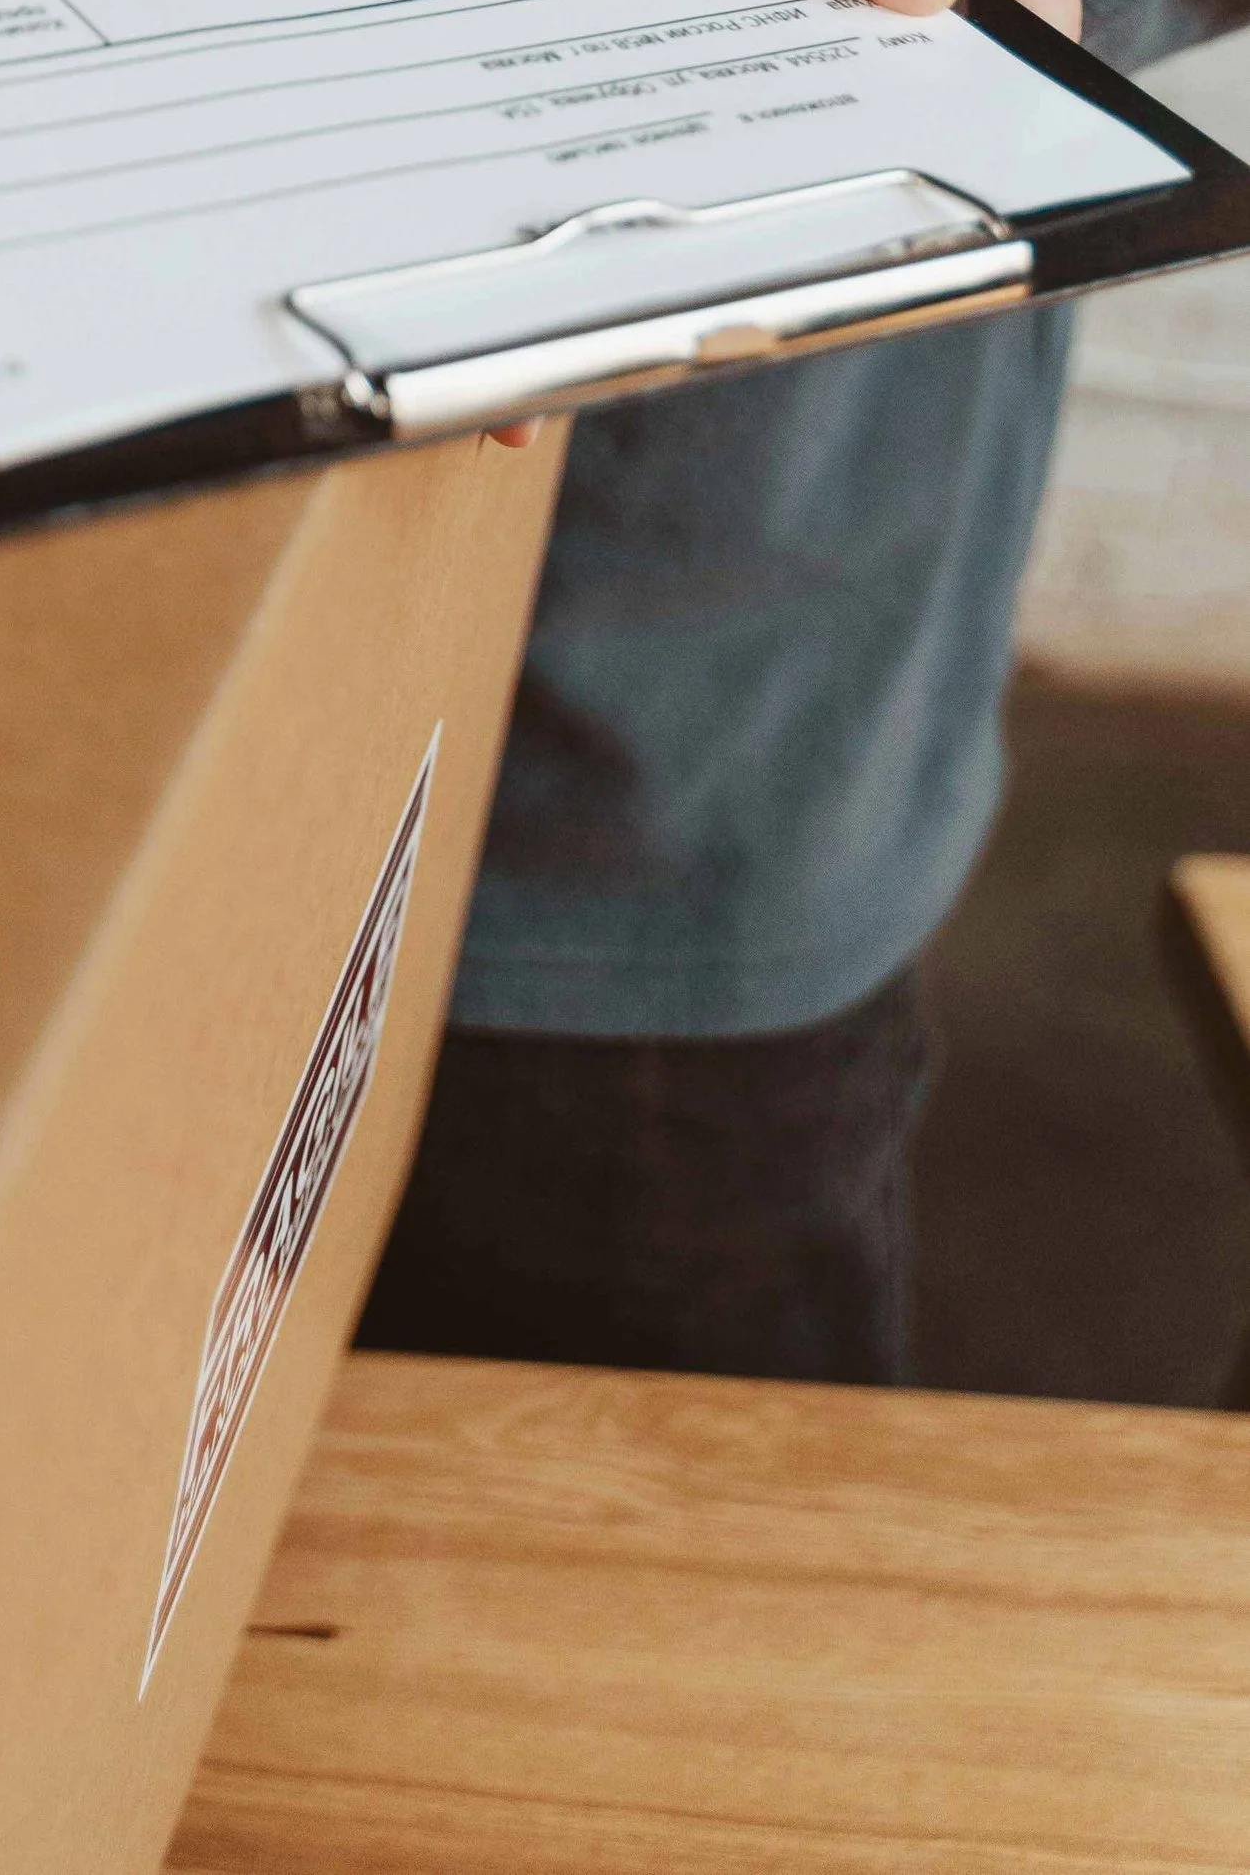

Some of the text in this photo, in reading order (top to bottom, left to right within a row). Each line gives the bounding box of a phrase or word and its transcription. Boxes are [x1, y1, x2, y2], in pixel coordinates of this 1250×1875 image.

[740, 7, 808, 28] ИФНС
[664, 19, 743, 39] России
[876, 32, 932, 49] Кому
